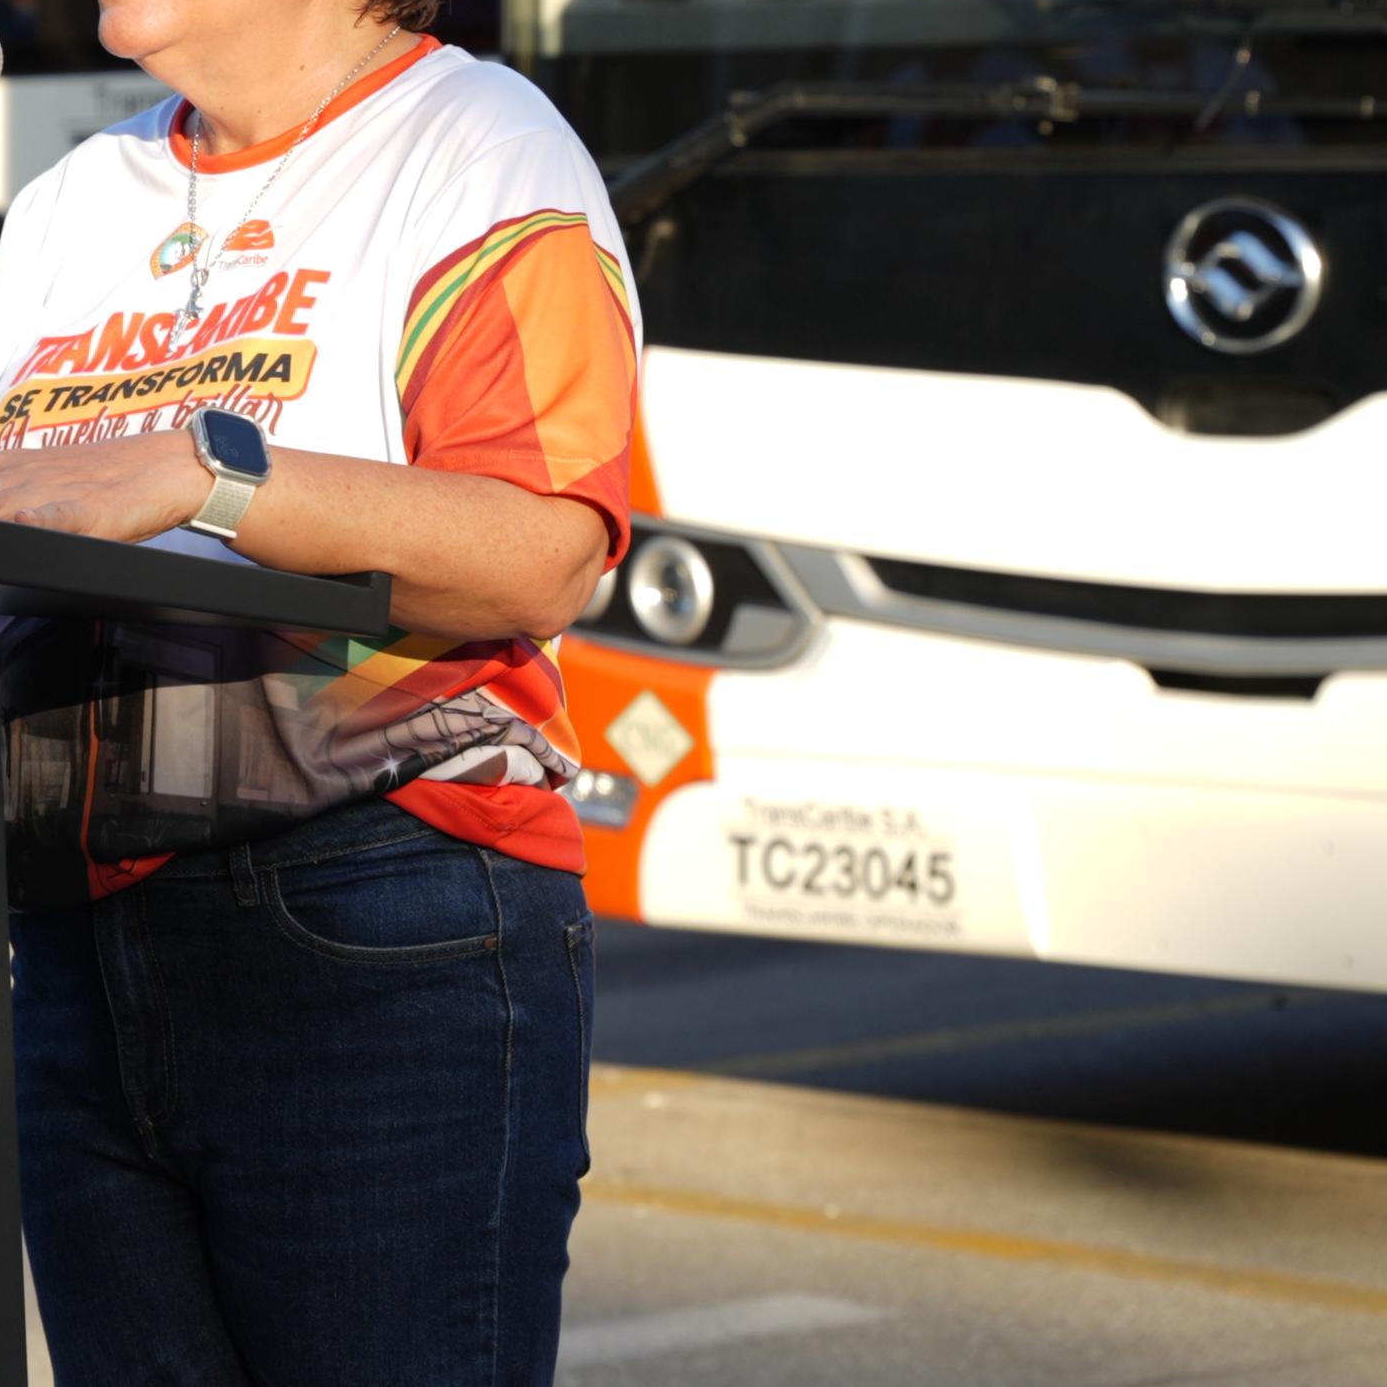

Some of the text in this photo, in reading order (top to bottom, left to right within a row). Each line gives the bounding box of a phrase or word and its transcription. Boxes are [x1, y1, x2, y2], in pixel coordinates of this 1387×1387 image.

[0, 351, 292, 425] SE TRANSFORMA
[140, 408, 161, 433] a
[728, 834, 957, 907] TC23045
